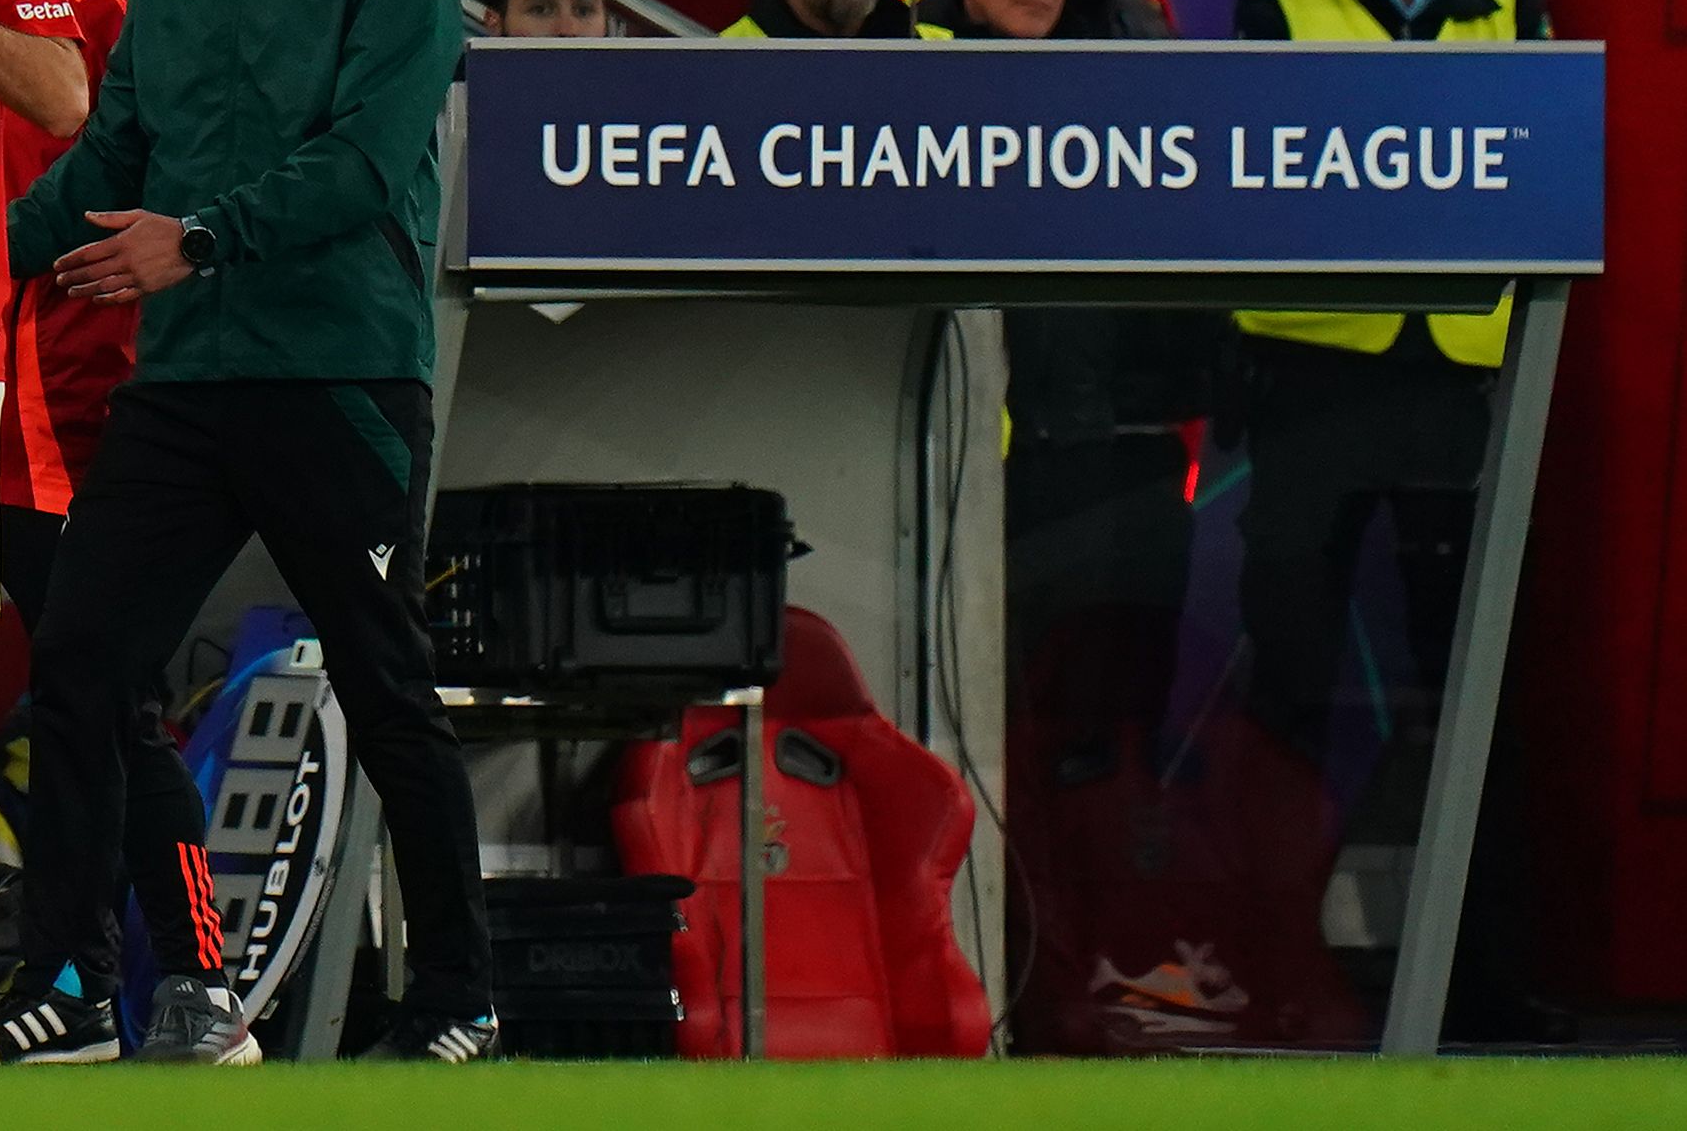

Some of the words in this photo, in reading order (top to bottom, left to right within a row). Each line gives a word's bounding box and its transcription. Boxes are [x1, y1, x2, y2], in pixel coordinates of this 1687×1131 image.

[16, 2, 75, 20] Betan
[542, 123, 736, 187] UEFA
[759, 123, 1198, 189] CHAMPIONS
[1230, 125, 1509, 189] LEAGUE
[239, 750, 320, 981] HUBLOT
